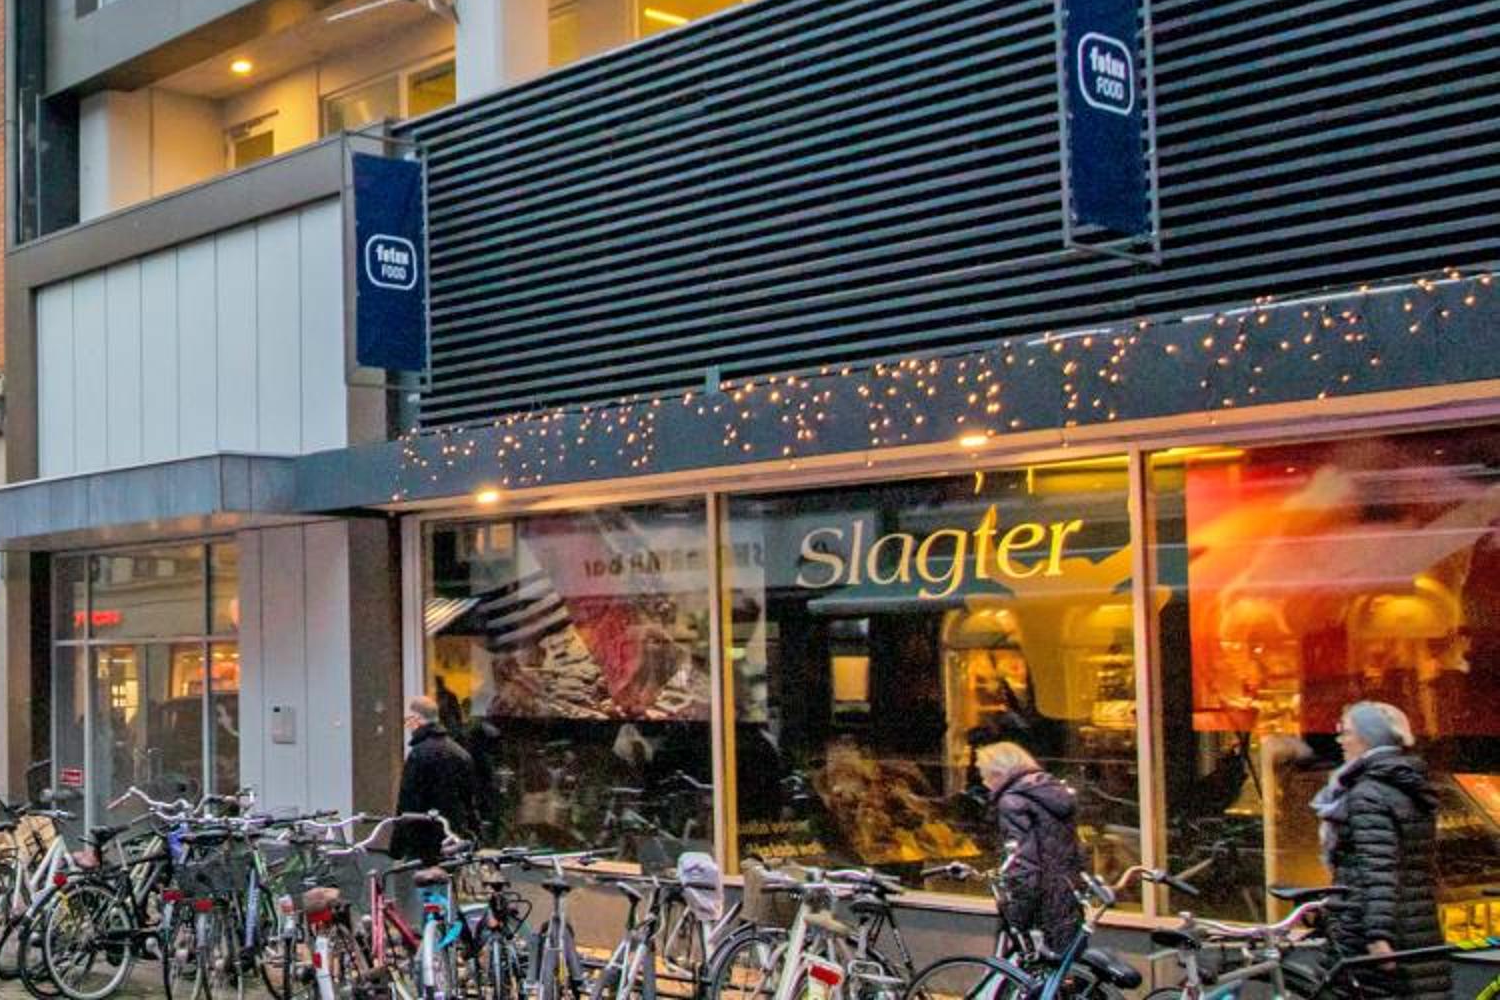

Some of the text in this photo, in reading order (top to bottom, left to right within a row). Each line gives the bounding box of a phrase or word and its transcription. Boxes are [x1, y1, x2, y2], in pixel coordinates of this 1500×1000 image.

[1096, 76, 1124, 100] FOOD
[382, 264, 406, 280] FOOD
[795, 504, 1083, 600] Slagter
